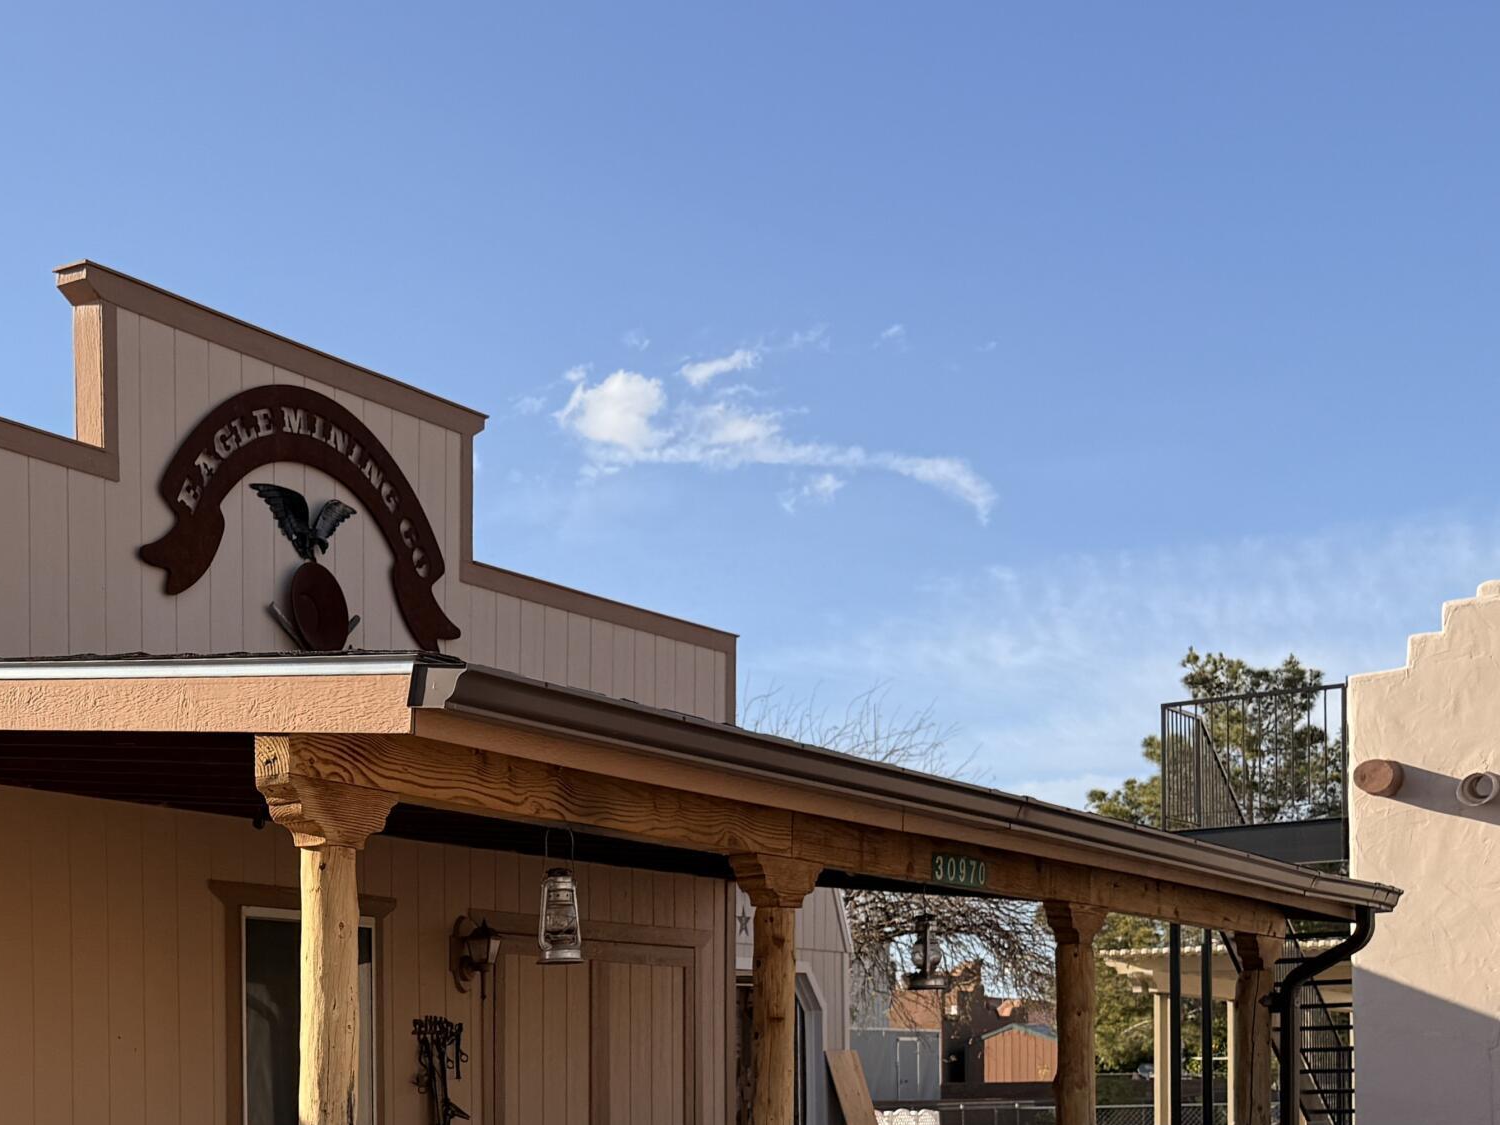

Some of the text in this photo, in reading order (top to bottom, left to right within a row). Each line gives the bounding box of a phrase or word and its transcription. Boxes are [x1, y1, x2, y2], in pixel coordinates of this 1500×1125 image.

[177, 408, 275, 515] EAGLE
[280, 406, 399, 514] MINING
[934, 855, 986, 886] 30970
